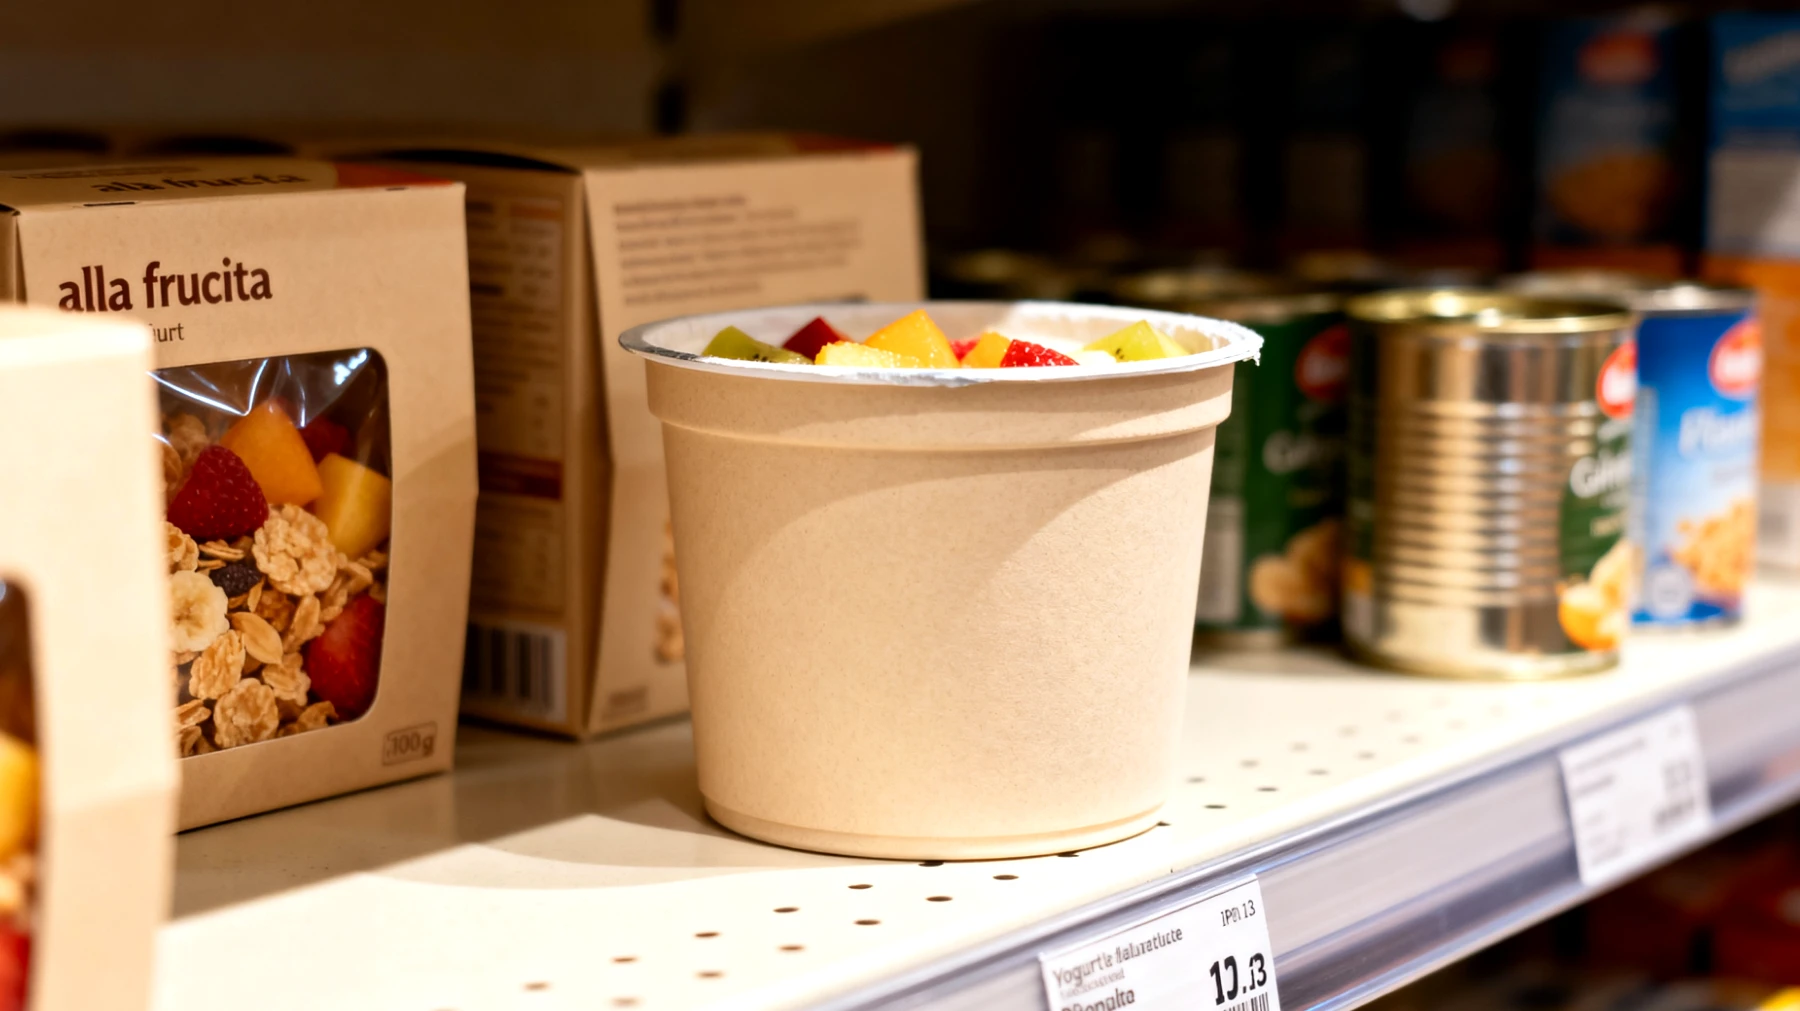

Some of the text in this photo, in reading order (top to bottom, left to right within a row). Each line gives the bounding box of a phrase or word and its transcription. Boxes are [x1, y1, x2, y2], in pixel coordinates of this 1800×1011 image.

[58, 257, 273, 312] alla frucita
[1242, 899, 1256, 919] 13
